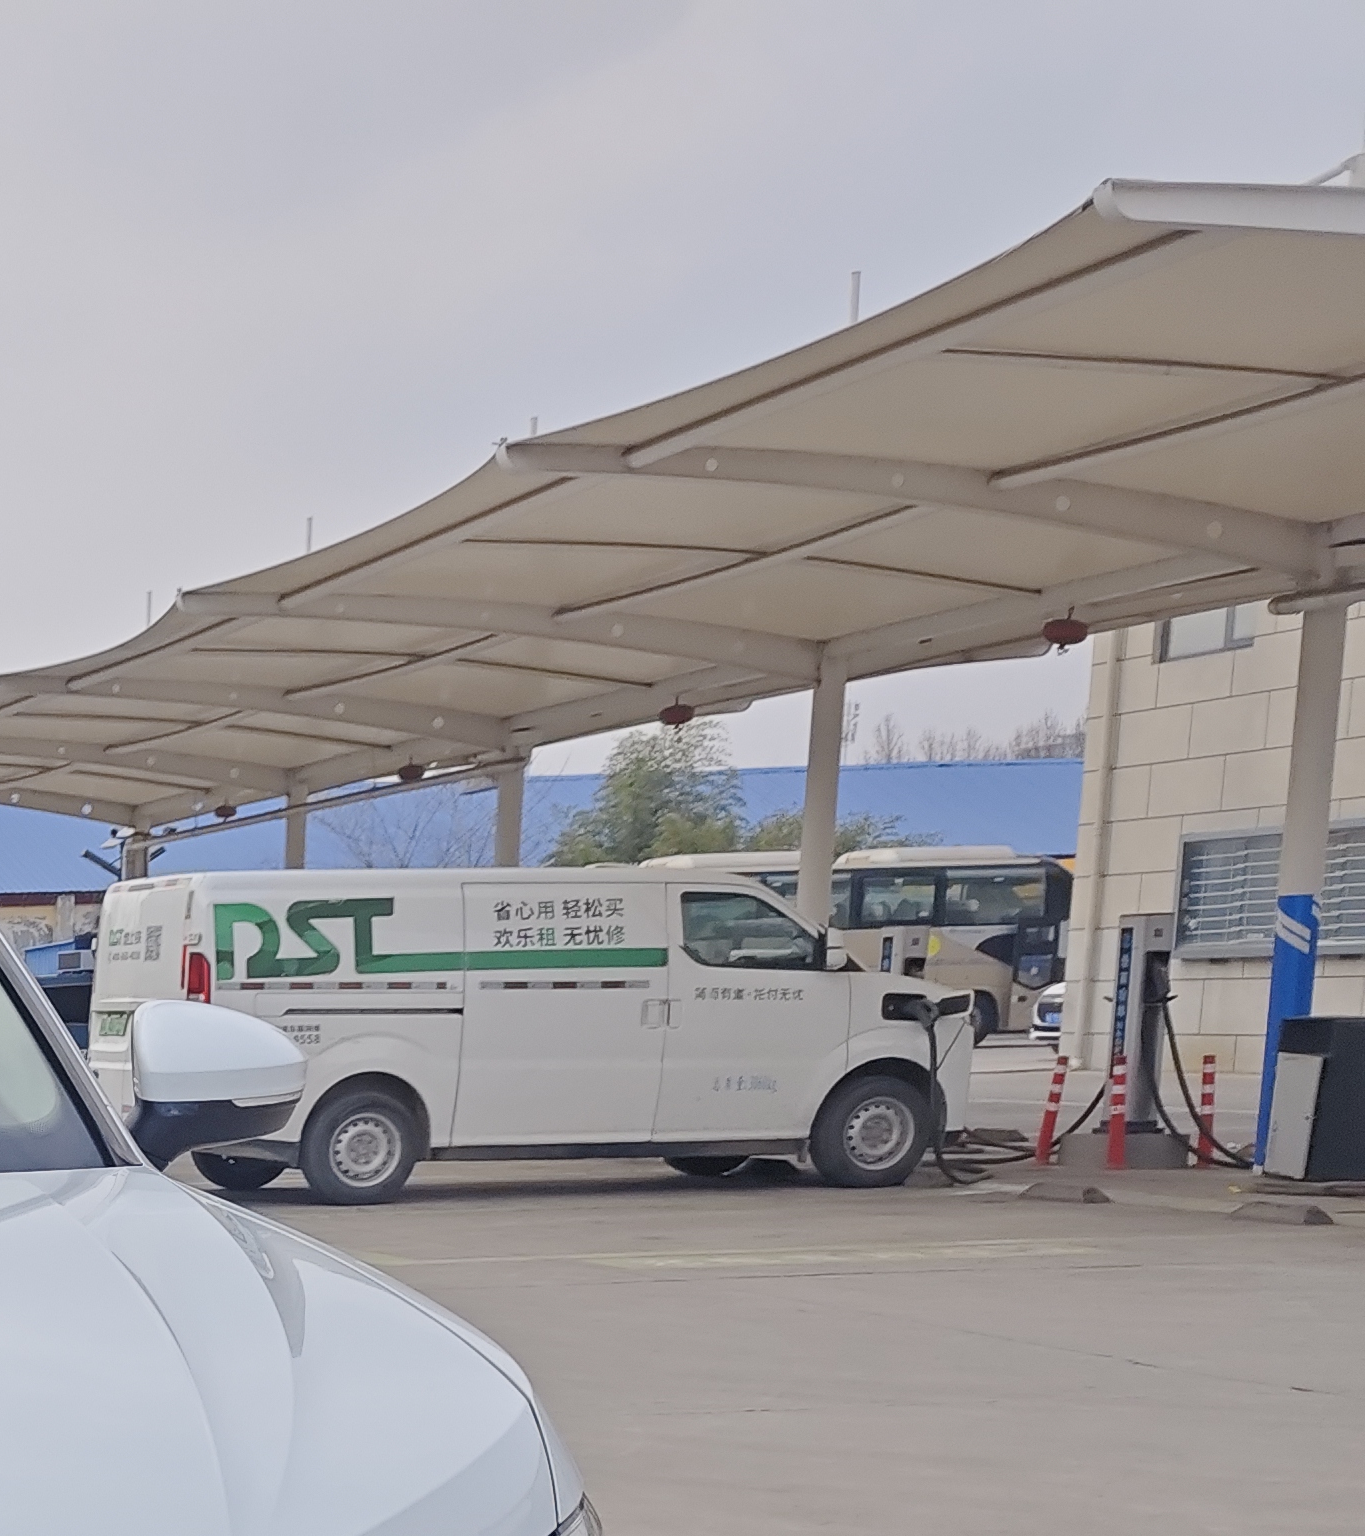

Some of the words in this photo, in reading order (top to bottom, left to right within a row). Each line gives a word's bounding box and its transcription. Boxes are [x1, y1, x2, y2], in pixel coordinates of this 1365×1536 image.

[493, 900, 555, 921] 省心用
[562, 898, 625, 919] 轻松买
[213, 897, 395, 981] DST
[493, 927, 557, 948] 欢乐租
[563, 925, 626, 946] 无忧修
